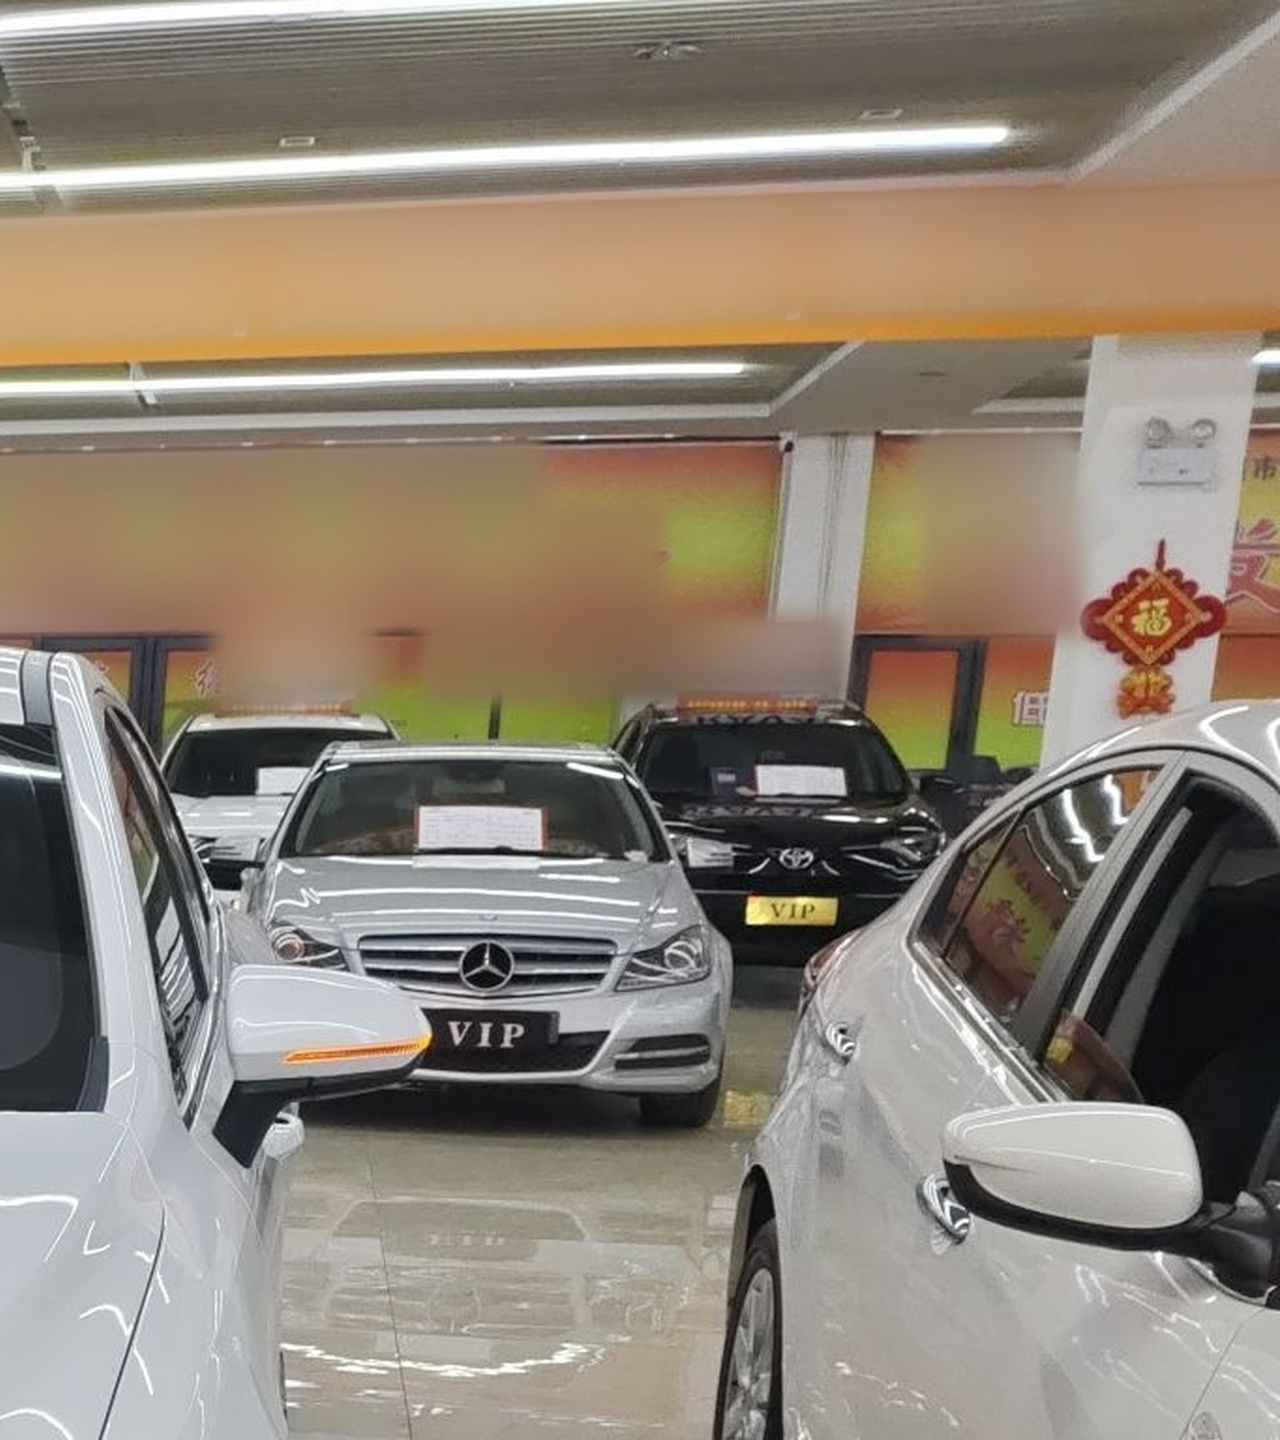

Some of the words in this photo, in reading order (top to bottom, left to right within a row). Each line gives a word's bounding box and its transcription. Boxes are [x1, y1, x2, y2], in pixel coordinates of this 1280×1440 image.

[1131, 598, 1172, 637] 福
[770, 902, 816, 919] VIP
[447, 1020, 526, 1049] VIP
